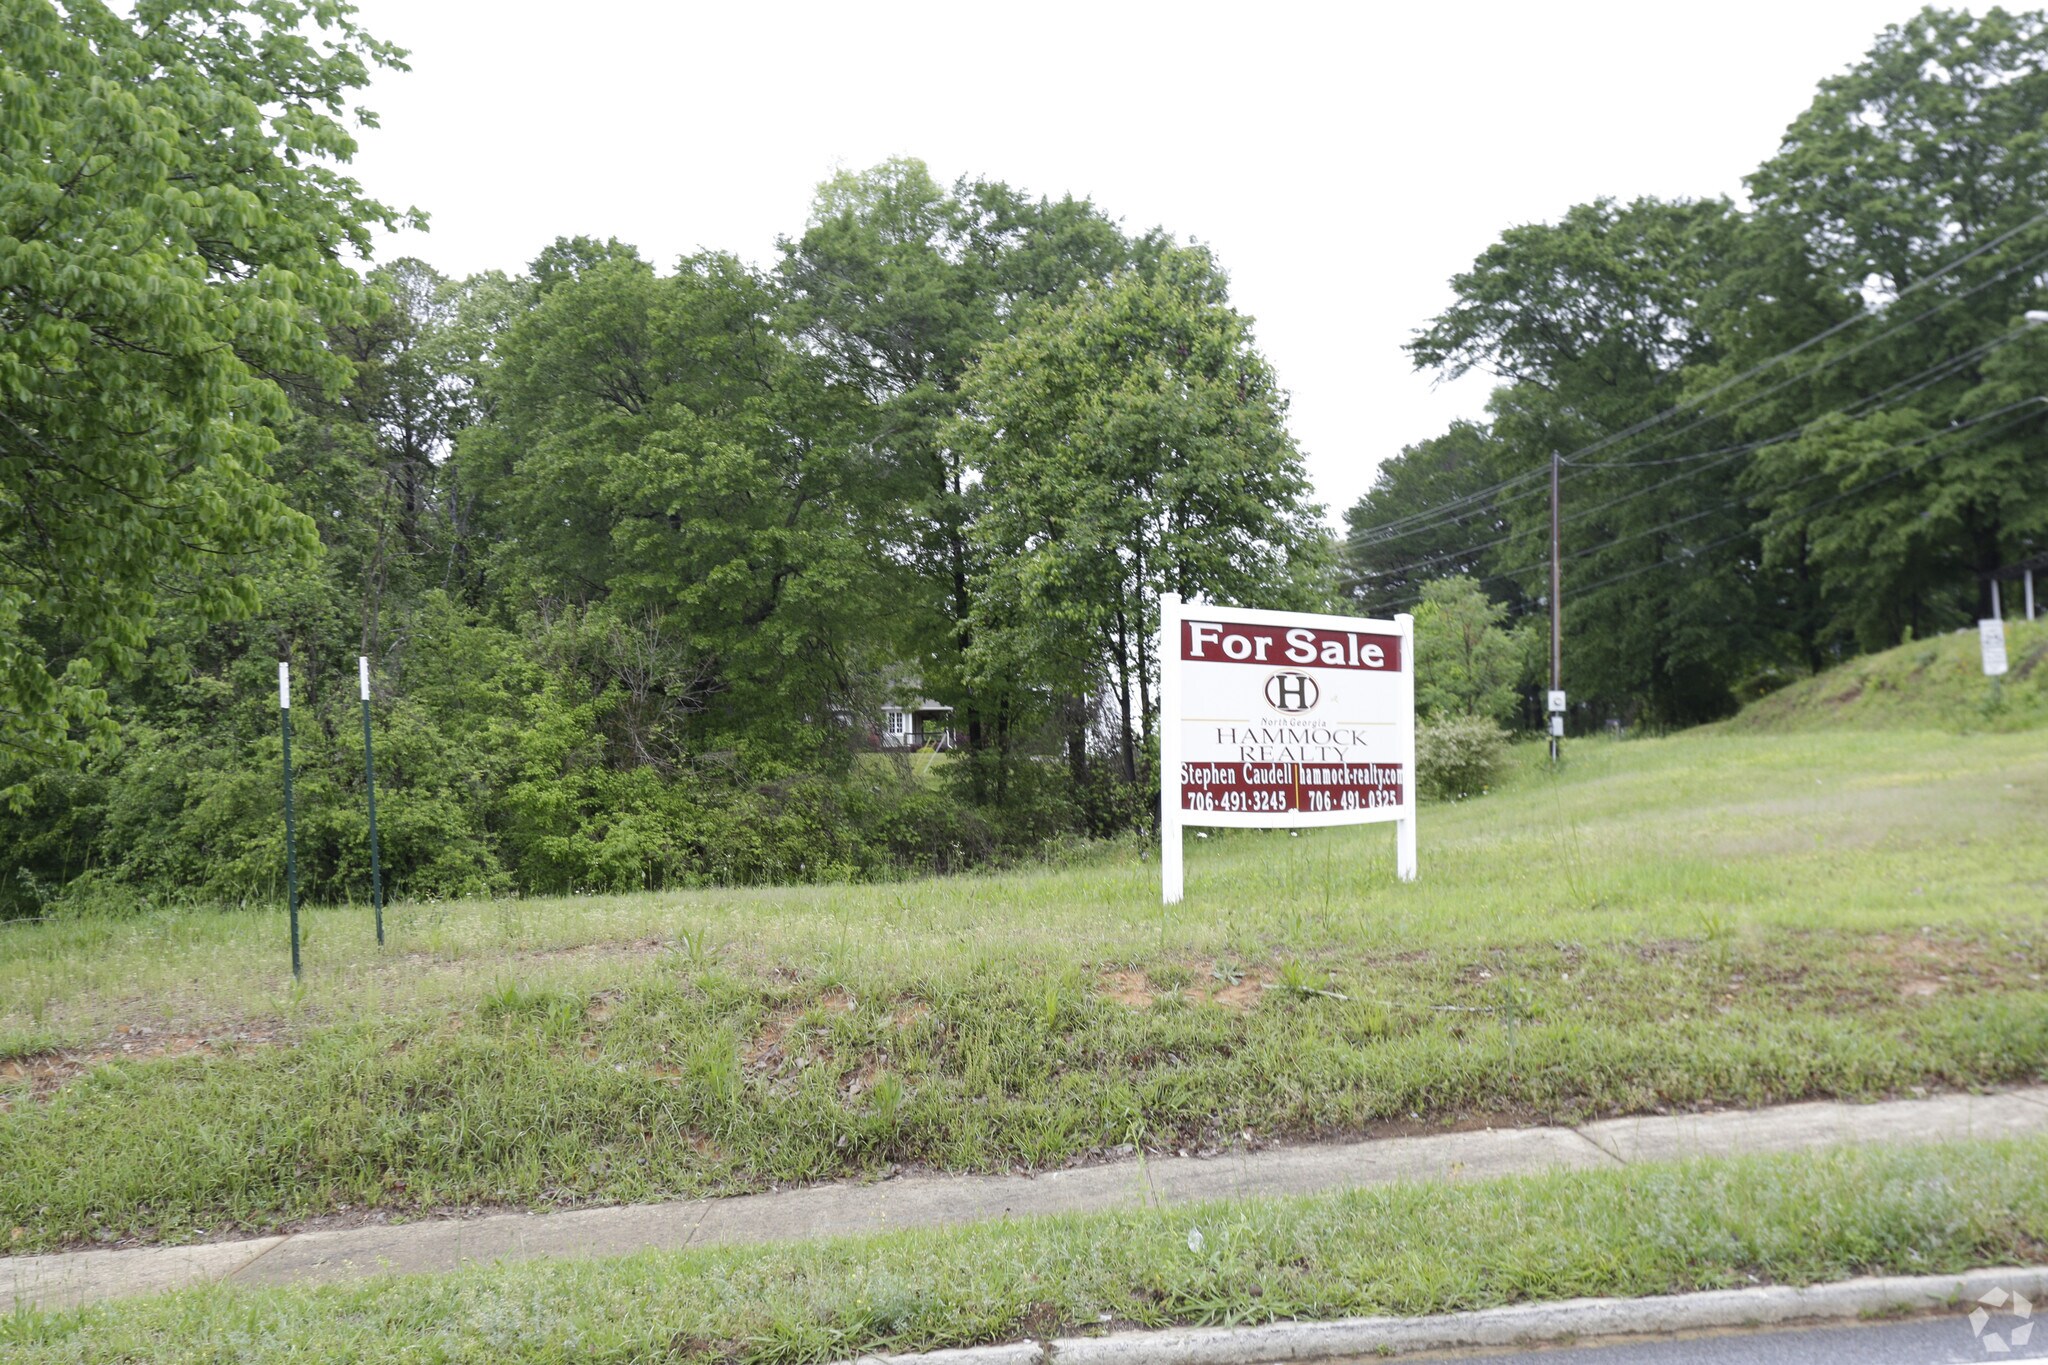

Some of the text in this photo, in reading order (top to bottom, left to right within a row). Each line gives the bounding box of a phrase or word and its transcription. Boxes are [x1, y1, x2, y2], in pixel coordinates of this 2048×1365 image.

[1188, 621, 1385, 668] For Sale
[1275, 674, 1309, 709] H
[1261, 717, 1327, 729] North Georgia
[1216, 727, 1368, 746] HAMMOCK
[1239, 745, 1350, 762] REALTY
[1181, 762, 1293, 790] Stephen Caudell
